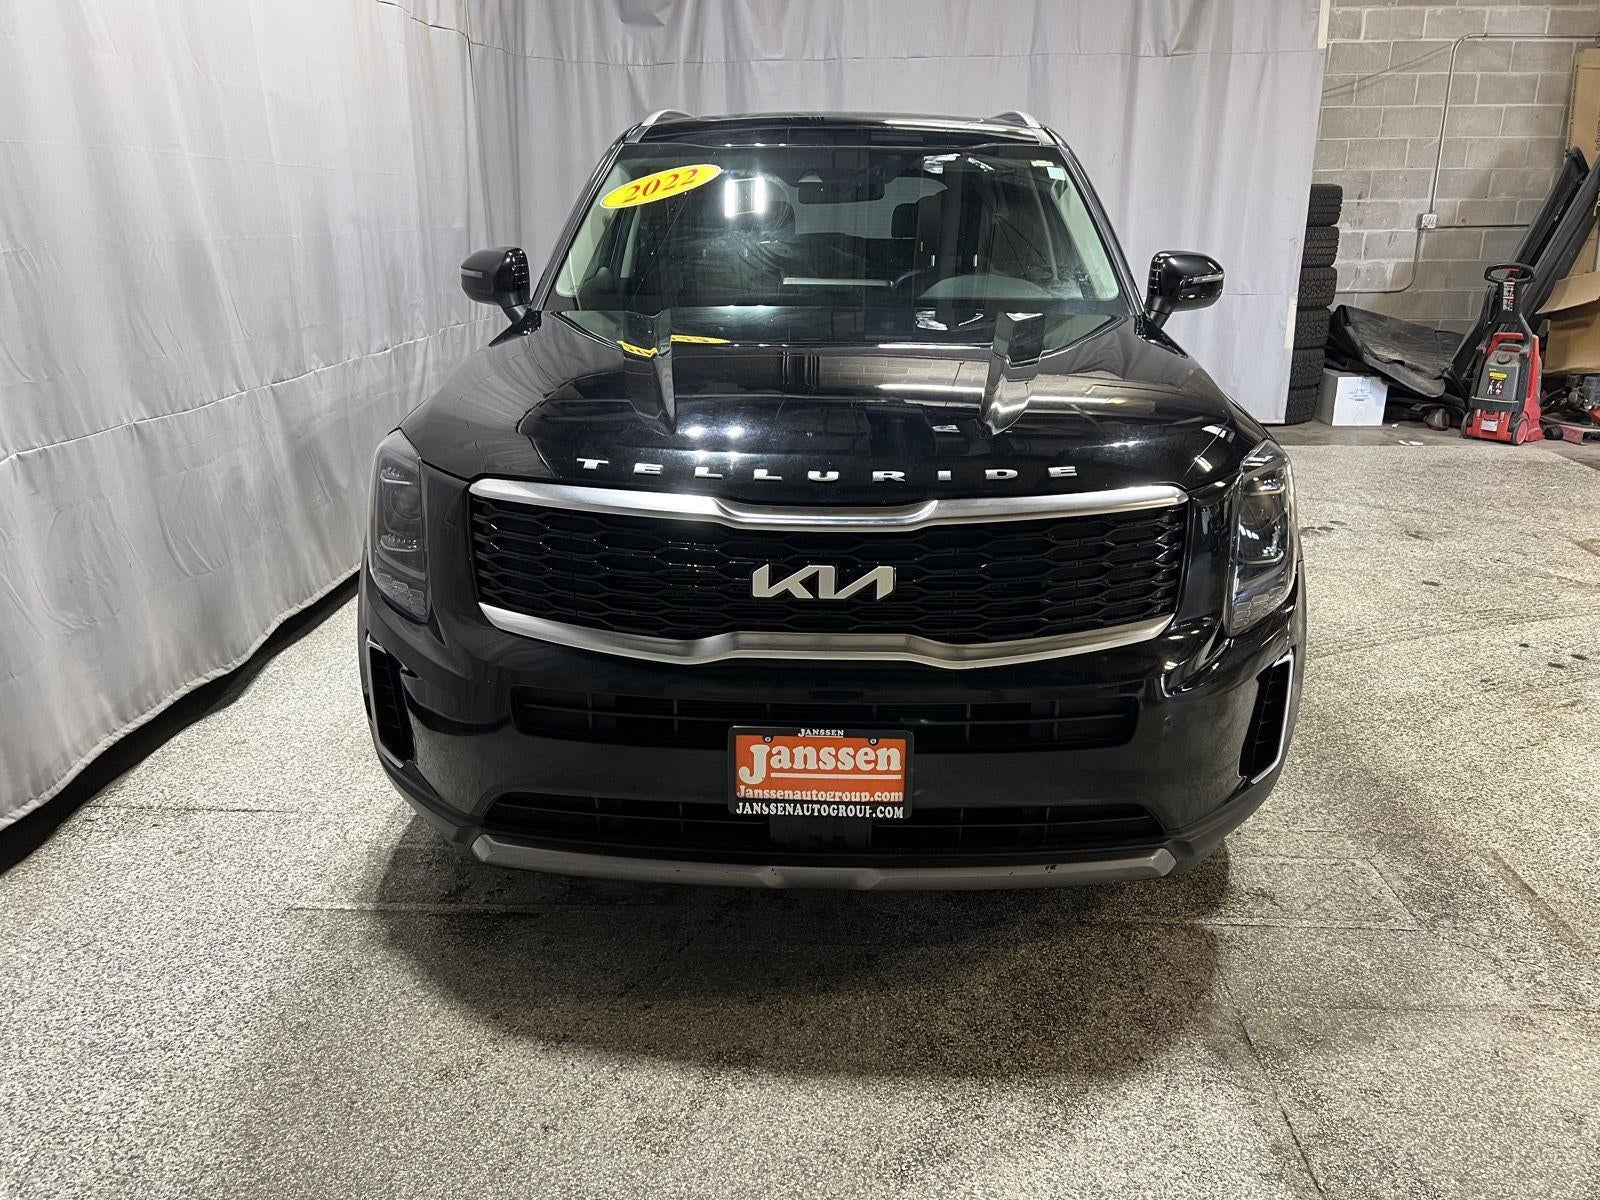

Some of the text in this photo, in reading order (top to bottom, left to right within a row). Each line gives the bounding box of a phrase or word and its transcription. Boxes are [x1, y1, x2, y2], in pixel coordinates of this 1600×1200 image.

[622, 168, 698, 204] 2022
[577, 456, 1077, 482] TELLURIDE
[752, 563, 895, 600] KIA
[798, 728, 844, 738] JANSSEN
[738, 744, 902, 785] Janssen
[737, 785, 904, 802] Janssenautogroup.com
